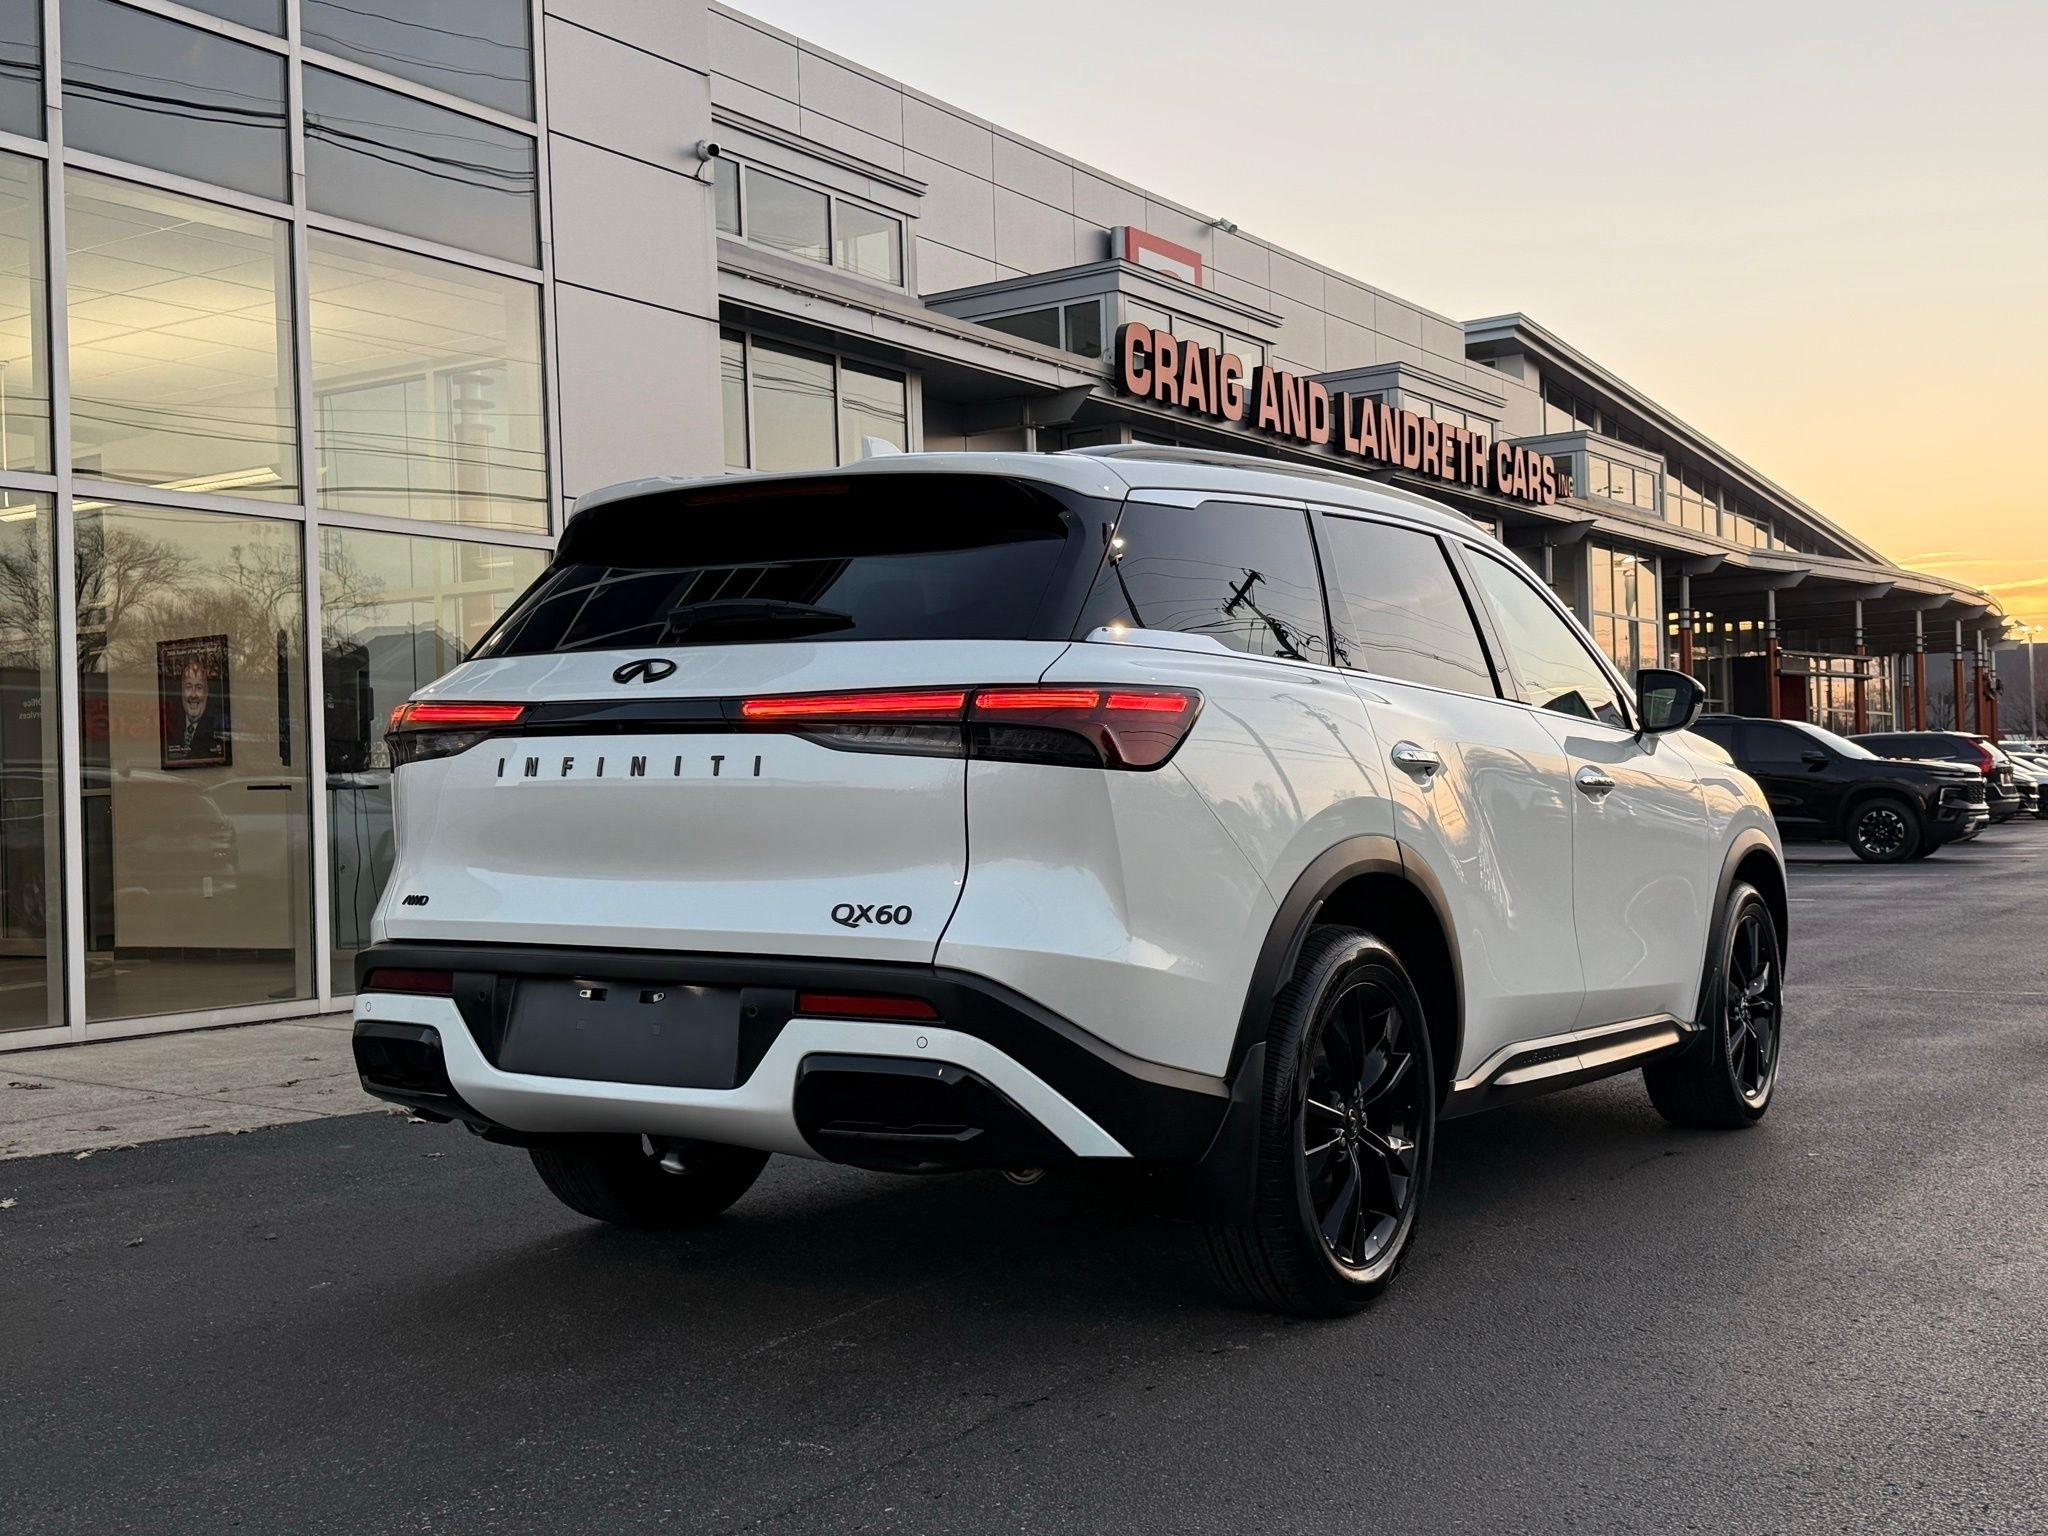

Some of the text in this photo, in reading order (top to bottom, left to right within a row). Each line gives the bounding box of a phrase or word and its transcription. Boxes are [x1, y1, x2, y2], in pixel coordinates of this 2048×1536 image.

[1123, 321, 1574, 506] CRAIG AND LANDRETH CARS INC
[497, 755, 762, 778] INFINITI
[401, 894, 430, 907] AWD
[831, 903, 913, 929] QX60
